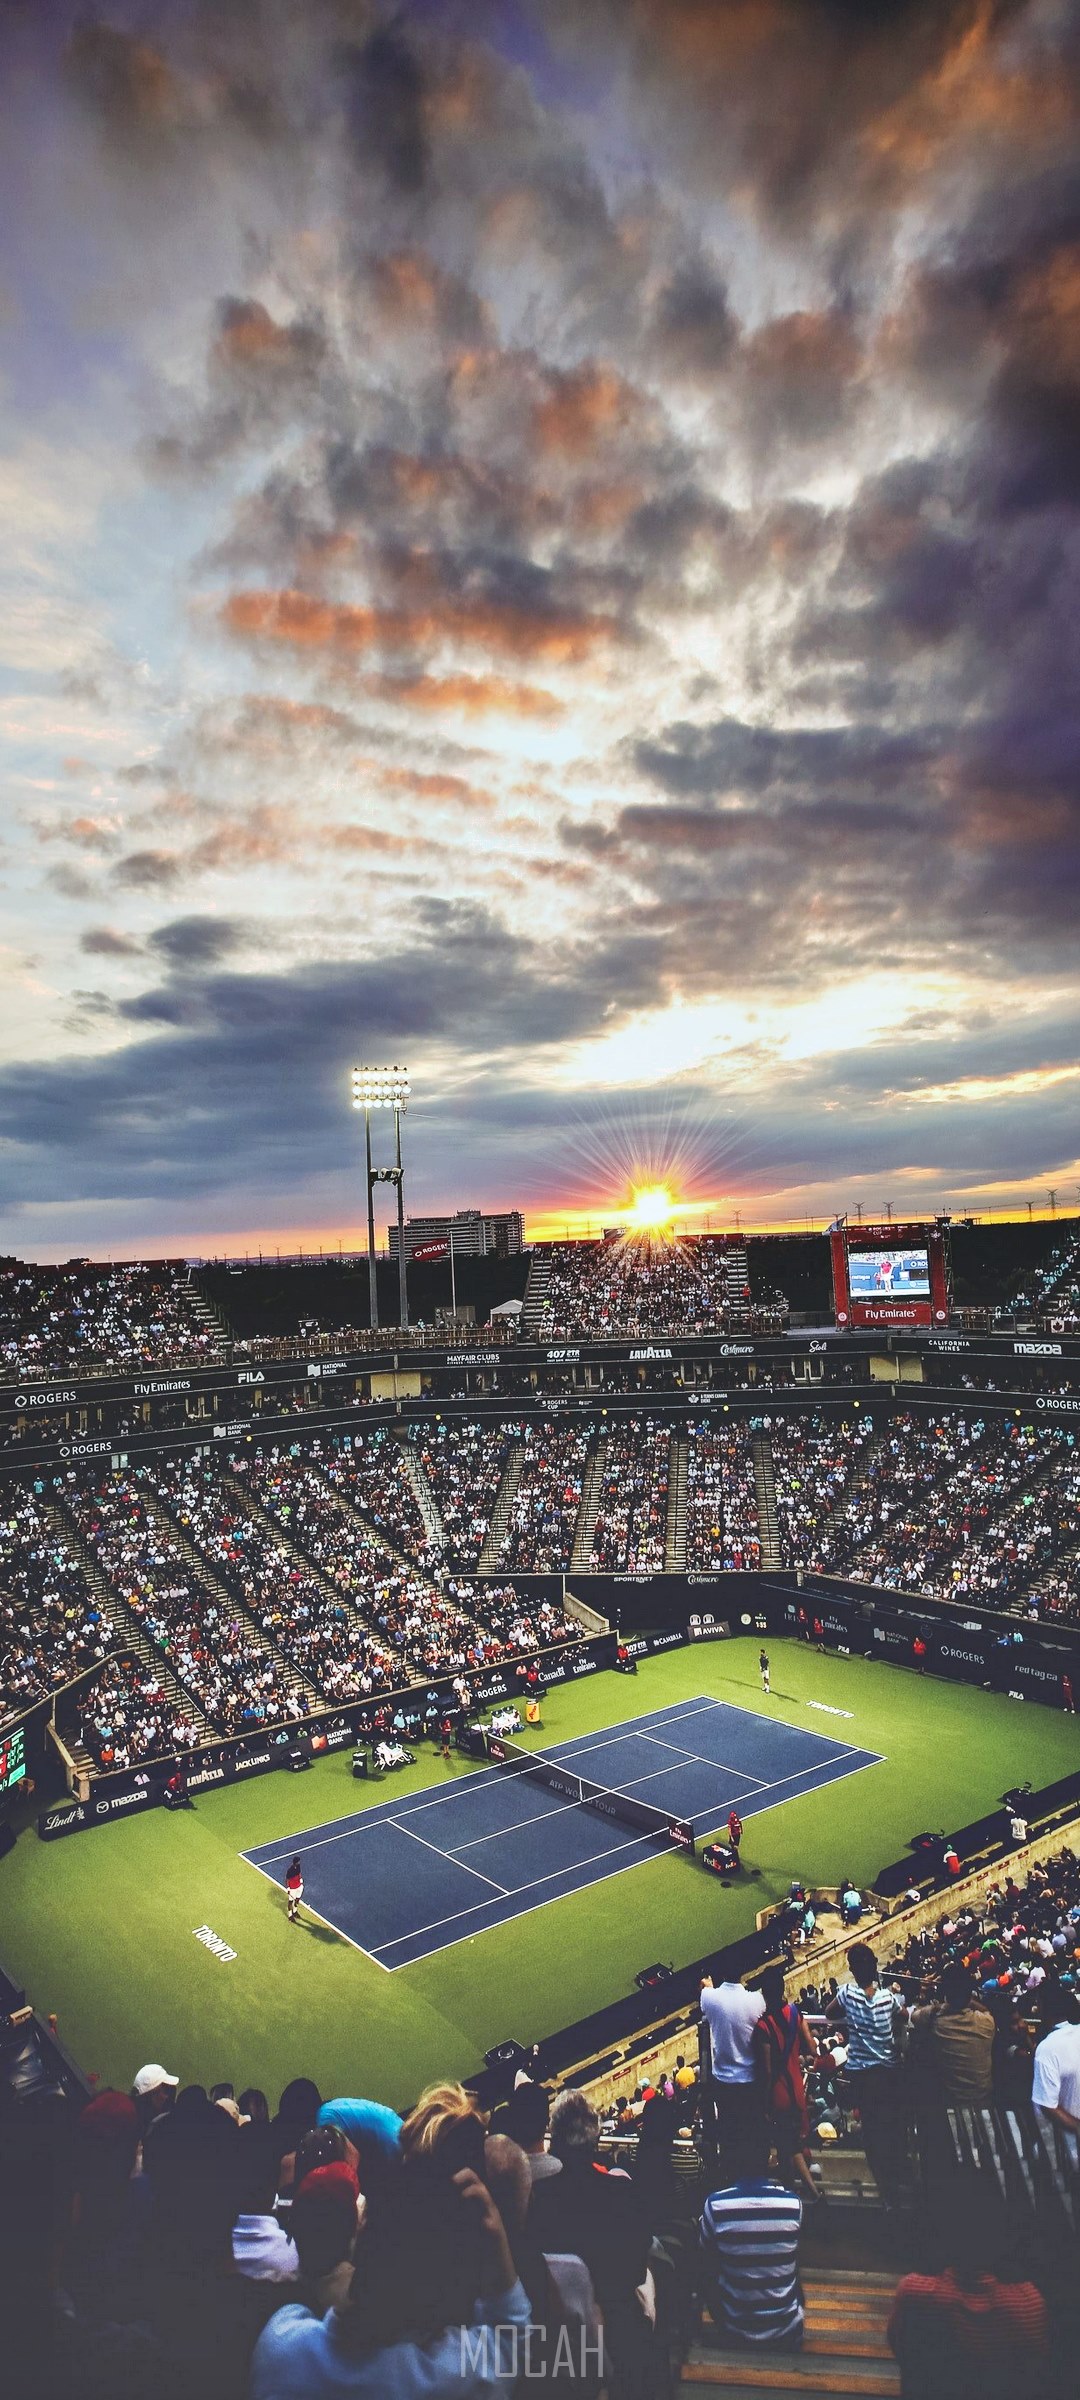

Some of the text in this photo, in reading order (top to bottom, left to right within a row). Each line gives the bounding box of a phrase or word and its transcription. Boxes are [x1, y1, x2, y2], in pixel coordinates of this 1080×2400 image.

[865, 1309, 916, 1319] Fly Emirates
[546, 1350, 566, 1358] 407
[629, 1347, 672, 1359] LAVAZZA
[1014, 1343, 1062, 1355] mazda
[238, 1371, 265, 1384] FILA
[134, 1380, 190, 1394] Fly Emirates
[30, 1391, 77, 1405] ROGERS
[72, 1442, 112, 1455] ROGERS
[702, 1626, 724, 1635] AVIVA
[838, 1645, 849, 1654] FILA
[950, 1648, 985, 1665] ROGERS
[538, 1666, 565, 1682] Canada
[477, 1684, 507, 1698] ROGERS
[1008, 1691, 1024, 1700] FILA
[327, 1728, 352, 1739] NATIONAL
[328, 1736, 344, 1745] BANK
[235, 1759, 251, 1771] JACK
[187, 1768, 224, 1787] LAVAZZA
[549, 1779, 564, 1790] ATP
[111, 1790, 148, 1808] mazda
[44, 1811, 76, 1830] Lindt
[704, 1854, 722, 1871] FedEx
[192, 1924, 238, 1962] TORONTO
